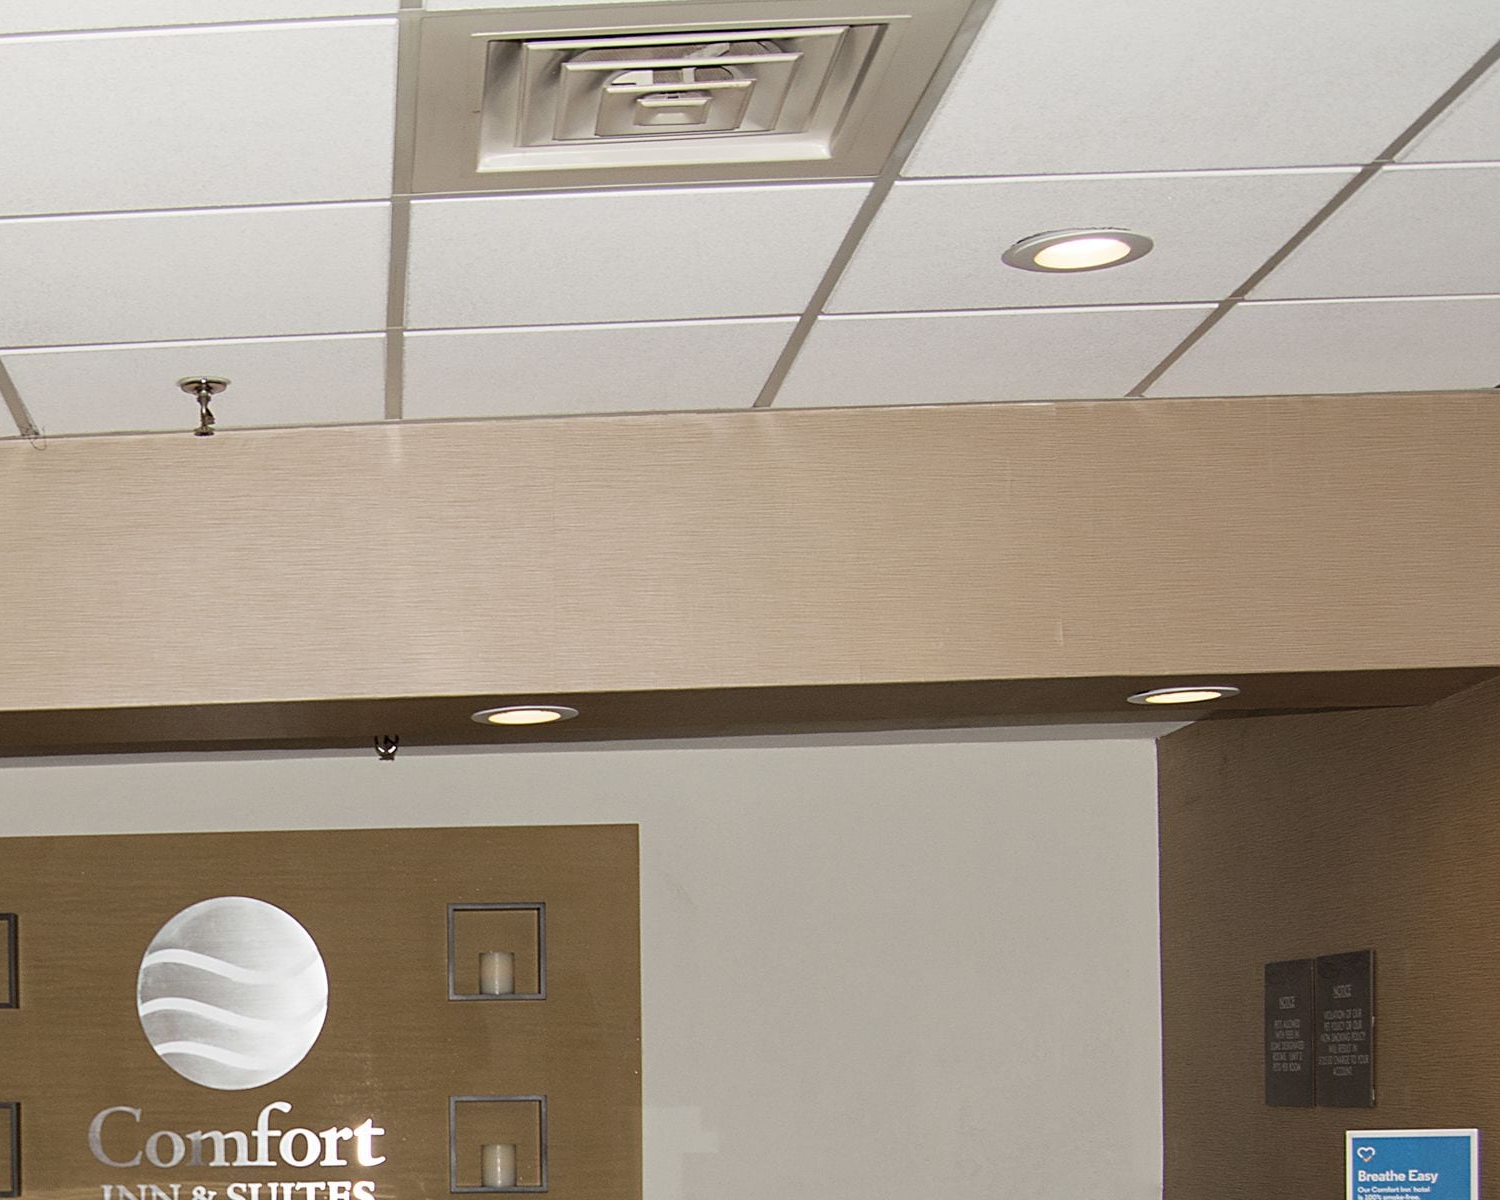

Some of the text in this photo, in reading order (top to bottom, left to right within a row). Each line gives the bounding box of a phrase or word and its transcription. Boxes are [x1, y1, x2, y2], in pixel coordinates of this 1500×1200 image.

[88, 1101, 386, 1168] Comfort
[1358, 1169, 1439, 1184] Breathe Easy
